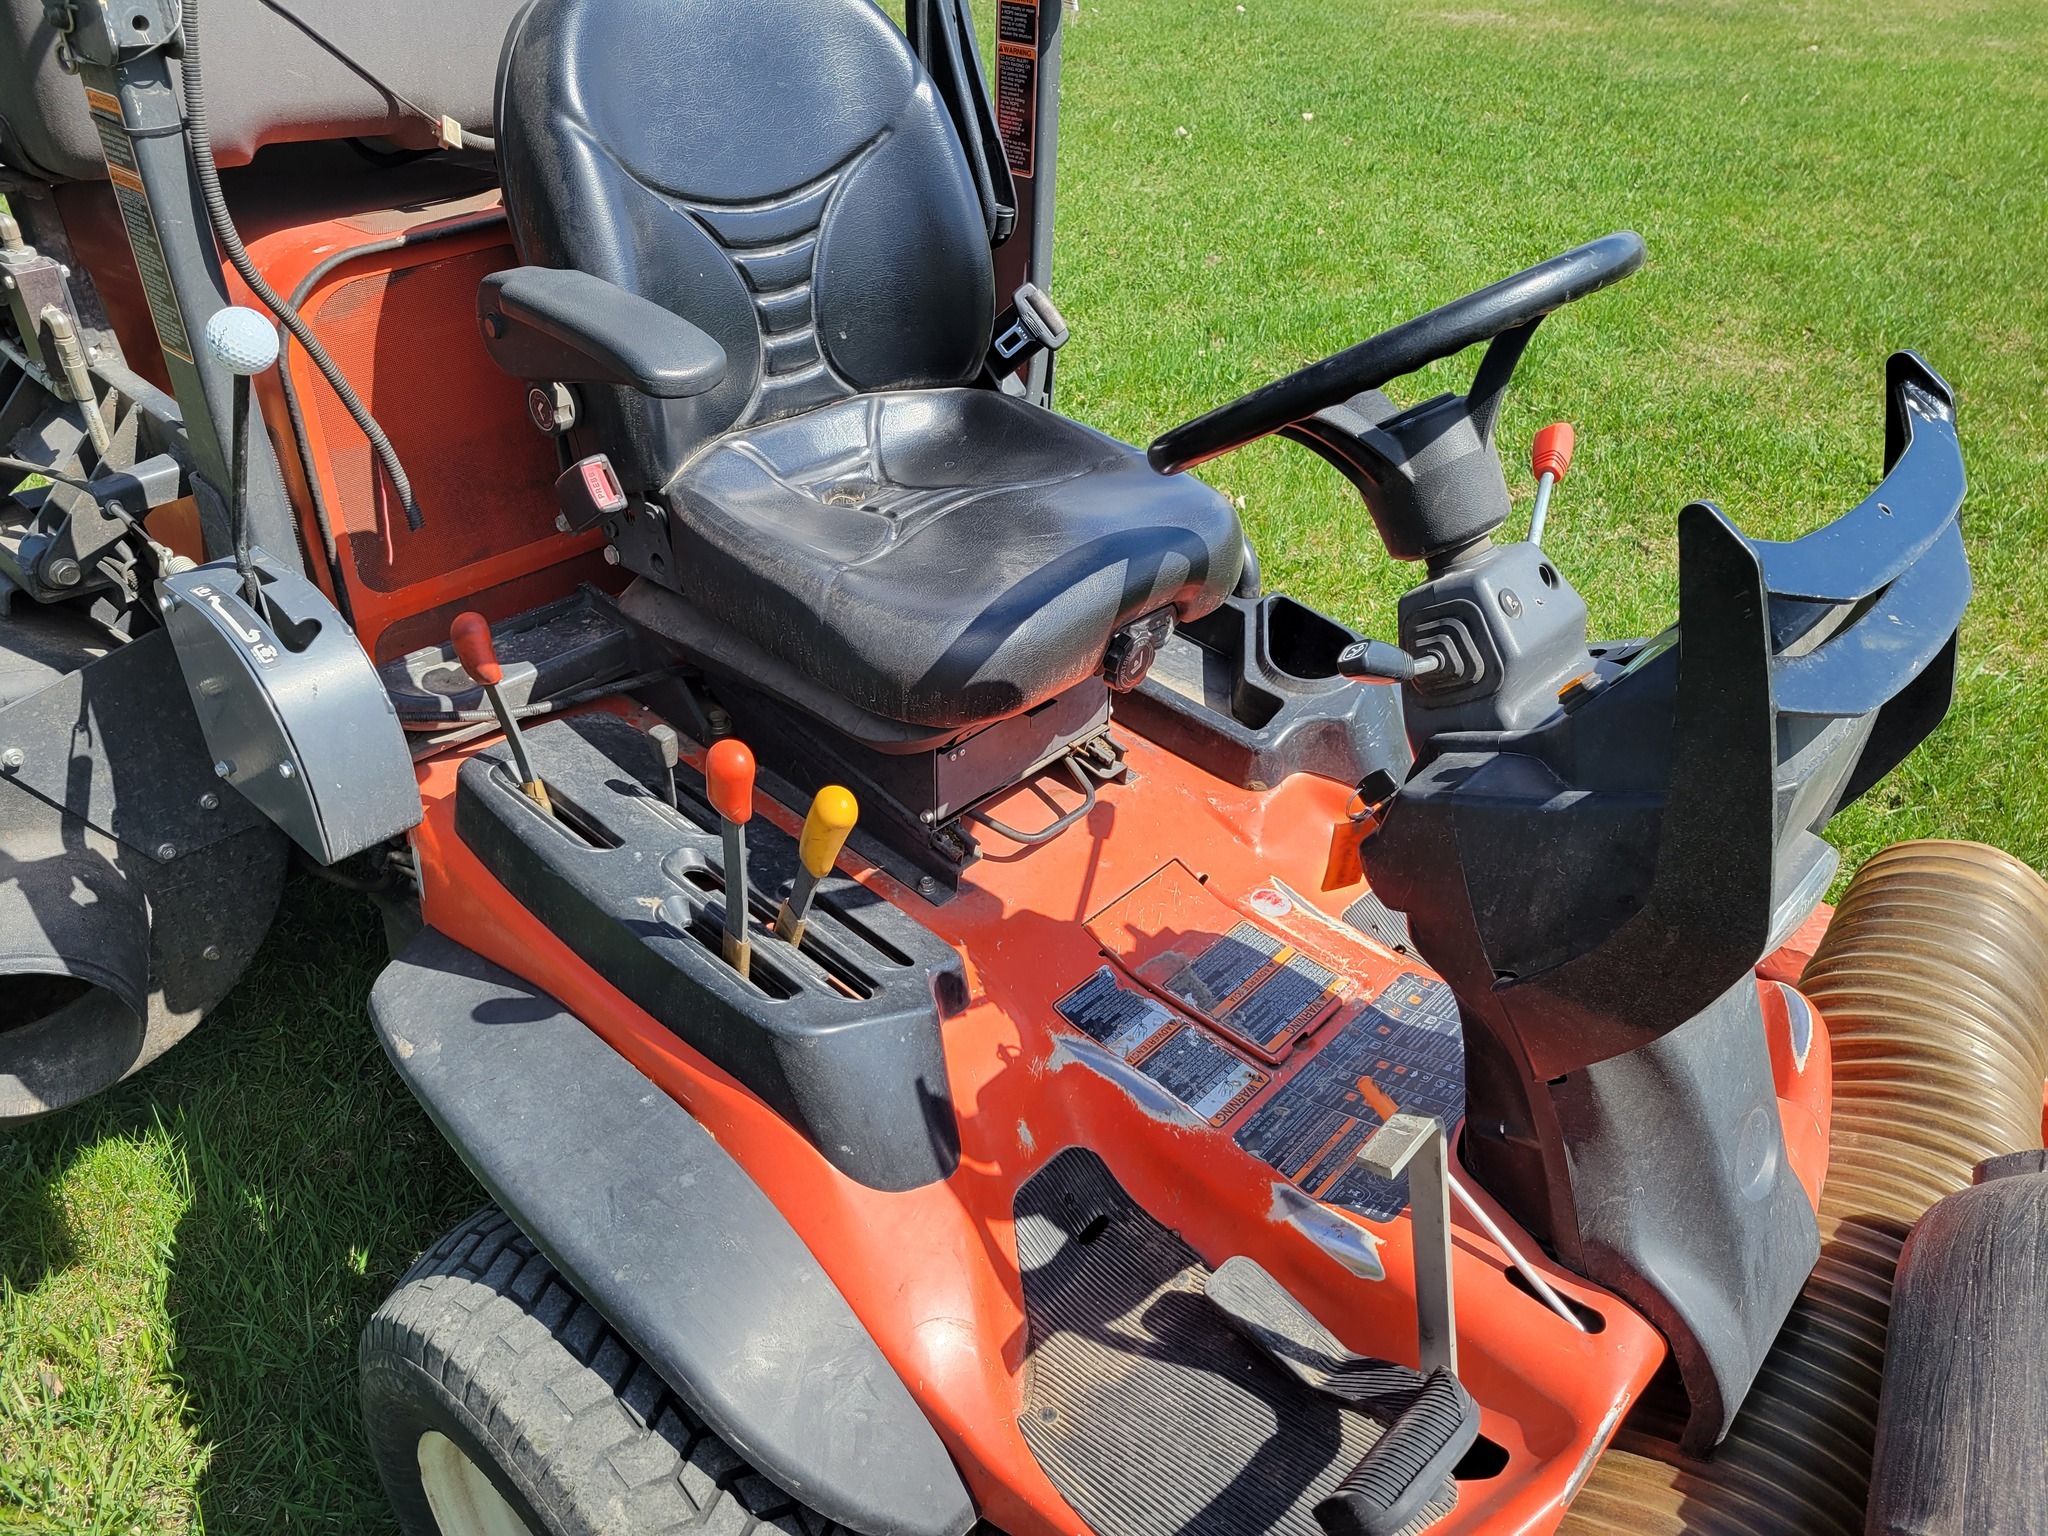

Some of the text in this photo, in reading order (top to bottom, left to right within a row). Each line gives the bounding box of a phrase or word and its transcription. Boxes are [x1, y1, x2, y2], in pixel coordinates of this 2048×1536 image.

[1003, 45, 1031, 57] WARNING
[589, 472, 605, 499] PRESS
[1256, 957, 1269, 967] PARA
[1242, 966, 1258, 979] EVITAR
[1306, 990, 1320, 1002] AVOID
[1283, 1000, 1323, 1034] WARNING
[1286, 1001, 1308, 1021] PERSONAL
[1271, 1020, 1288, 1034] INJURY
[1123, 1024, 1174, 1064] ADVERTENCIA
[1214, 1083, 1258, 1122] WARNING
[1303, 1138, 1334, 1169] ADVERTENCIA
